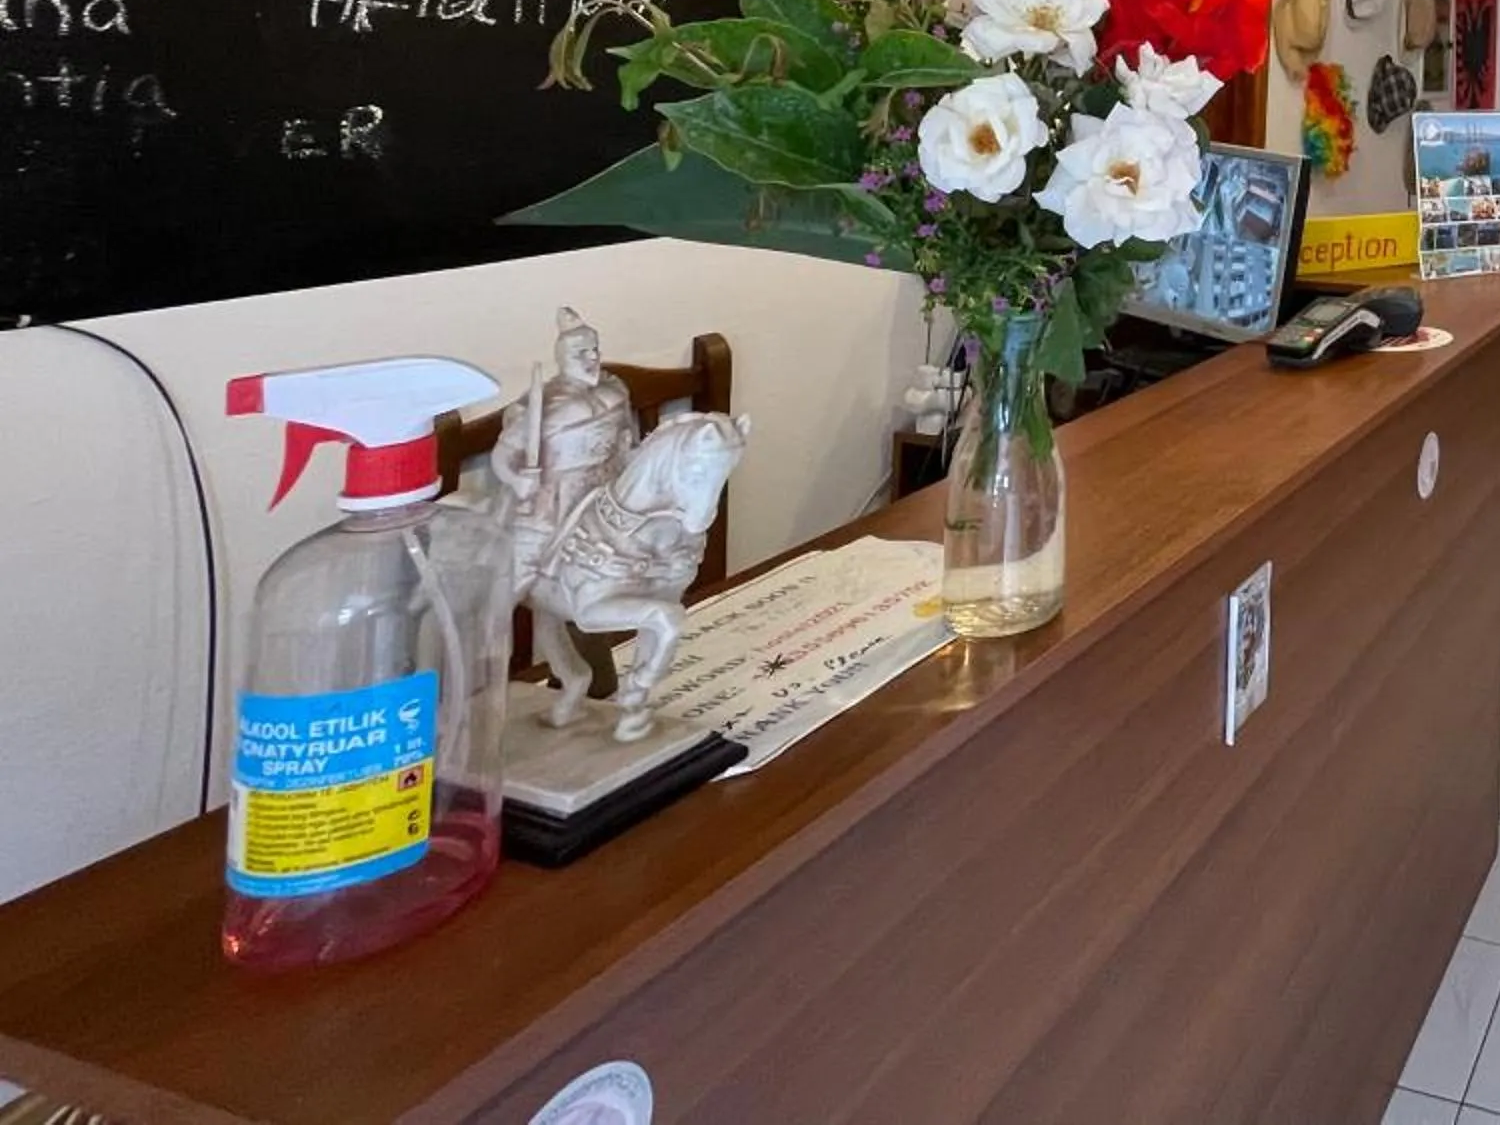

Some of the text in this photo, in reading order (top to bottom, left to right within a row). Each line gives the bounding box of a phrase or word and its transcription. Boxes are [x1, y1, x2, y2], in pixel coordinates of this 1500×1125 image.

[1300, 231, 1398, 272] ception
[308, 707, 387, 739] ETILIK
[261, 755, 329, 777] SPRAY
